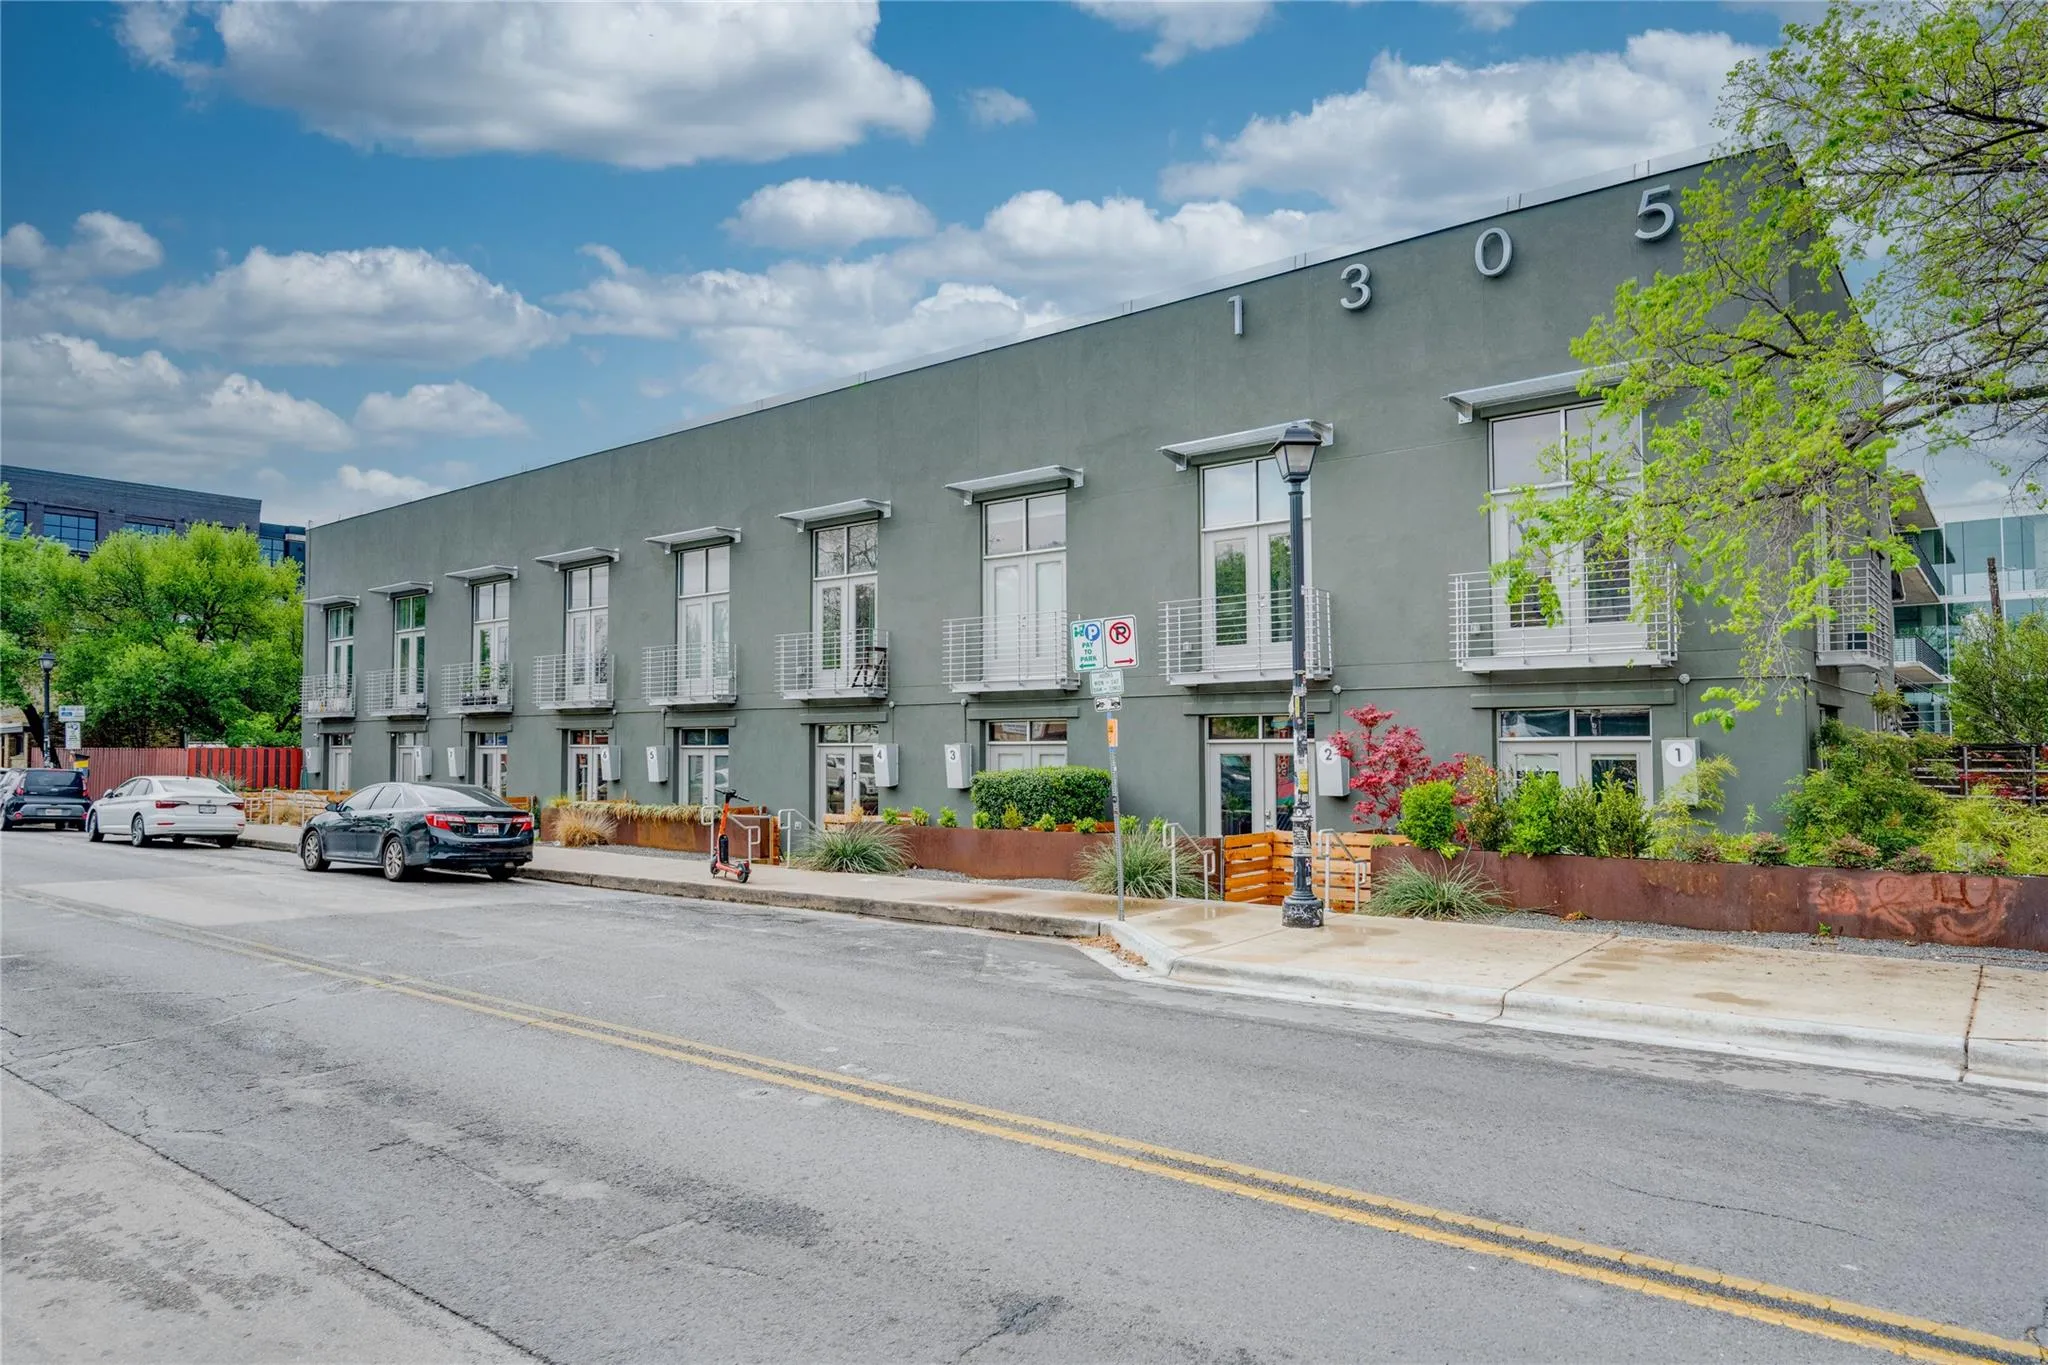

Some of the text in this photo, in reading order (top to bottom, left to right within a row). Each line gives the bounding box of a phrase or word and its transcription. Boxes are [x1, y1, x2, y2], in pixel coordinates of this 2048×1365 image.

[1227, 184, 1676, 337] 1 3 0 5
[876, 749, 882, 760] 4
[949, 749, 956, 761] 3
[1324, 748, 1332, 760] 2
[1675, 747, 1681, 762] 1
